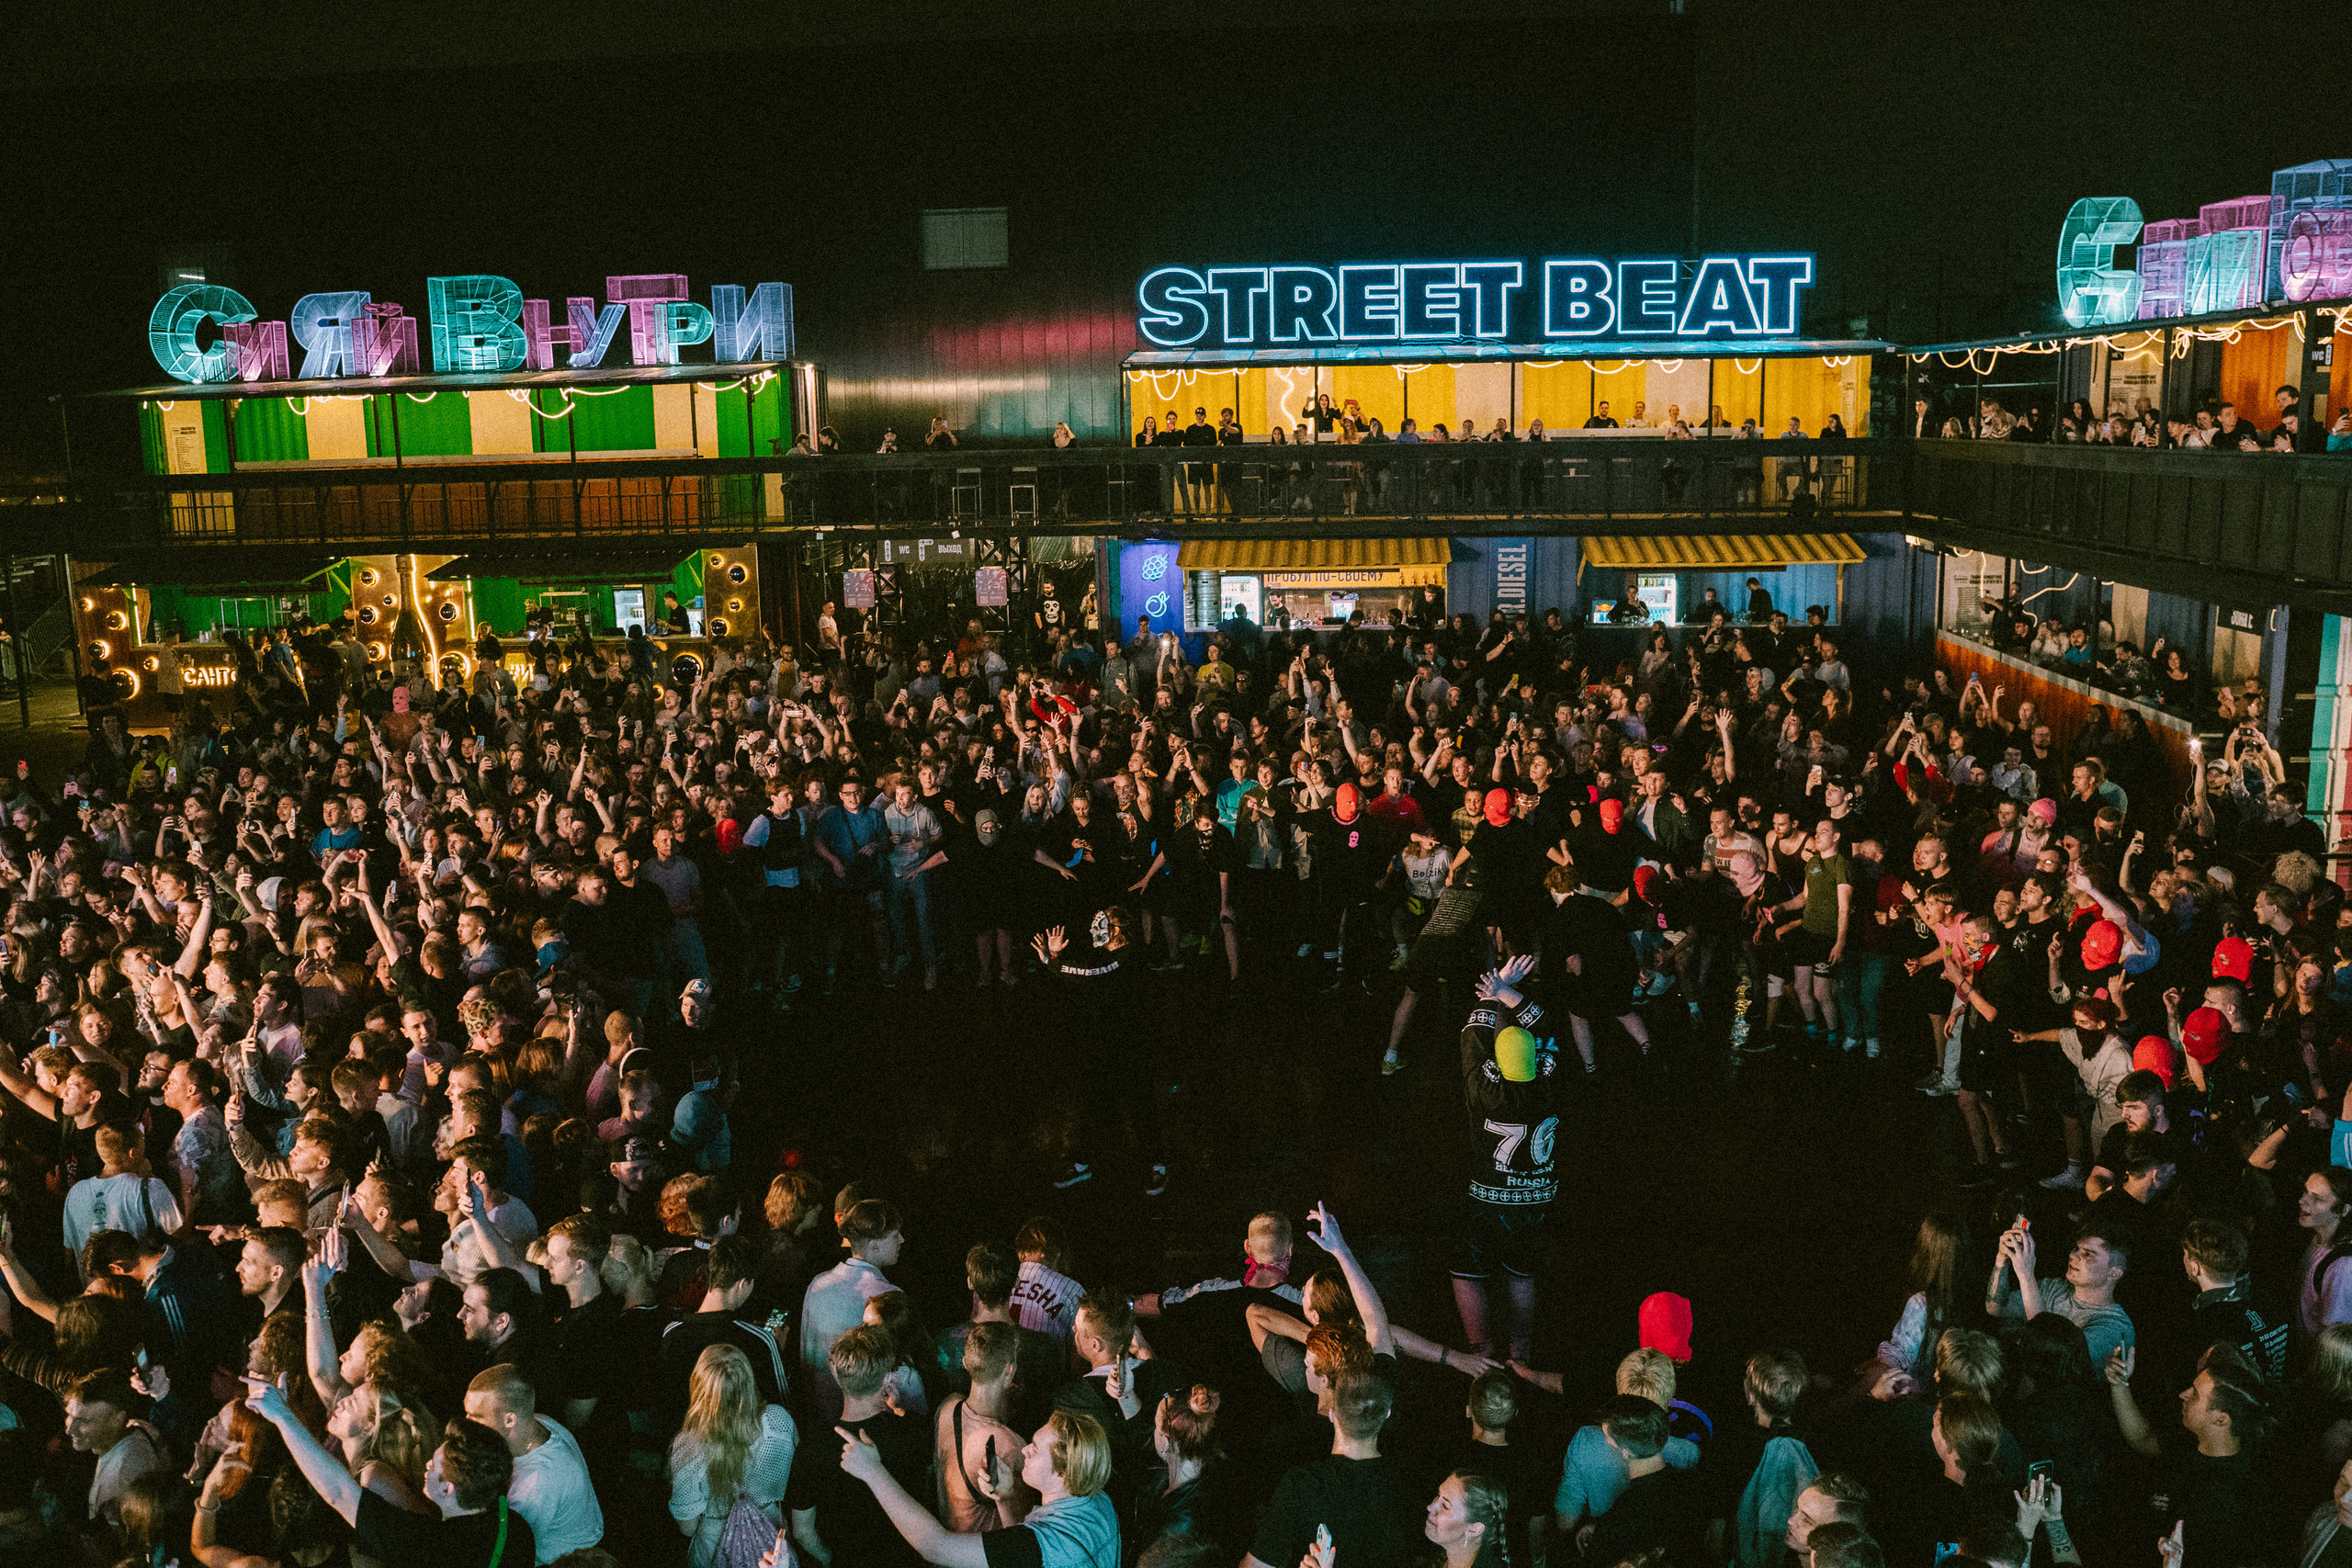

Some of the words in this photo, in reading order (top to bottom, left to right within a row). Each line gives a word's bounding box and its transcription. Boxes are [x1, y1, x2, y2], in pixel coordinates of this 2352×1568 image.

[1139, 263, 1522, 345] STREET
[1544, 258, 1811, 336] BEAT
[2312, 351, 2324, 361] WC
[899, 545, 910, 554] WC
[938, 544, 962, 555] ВЫХОД
[1497, 544, 1527, 623] R.DIESEL
[1484, 1117, 1560, 1166] 76
[1011, 1280, 1064, 1320] ESHA
